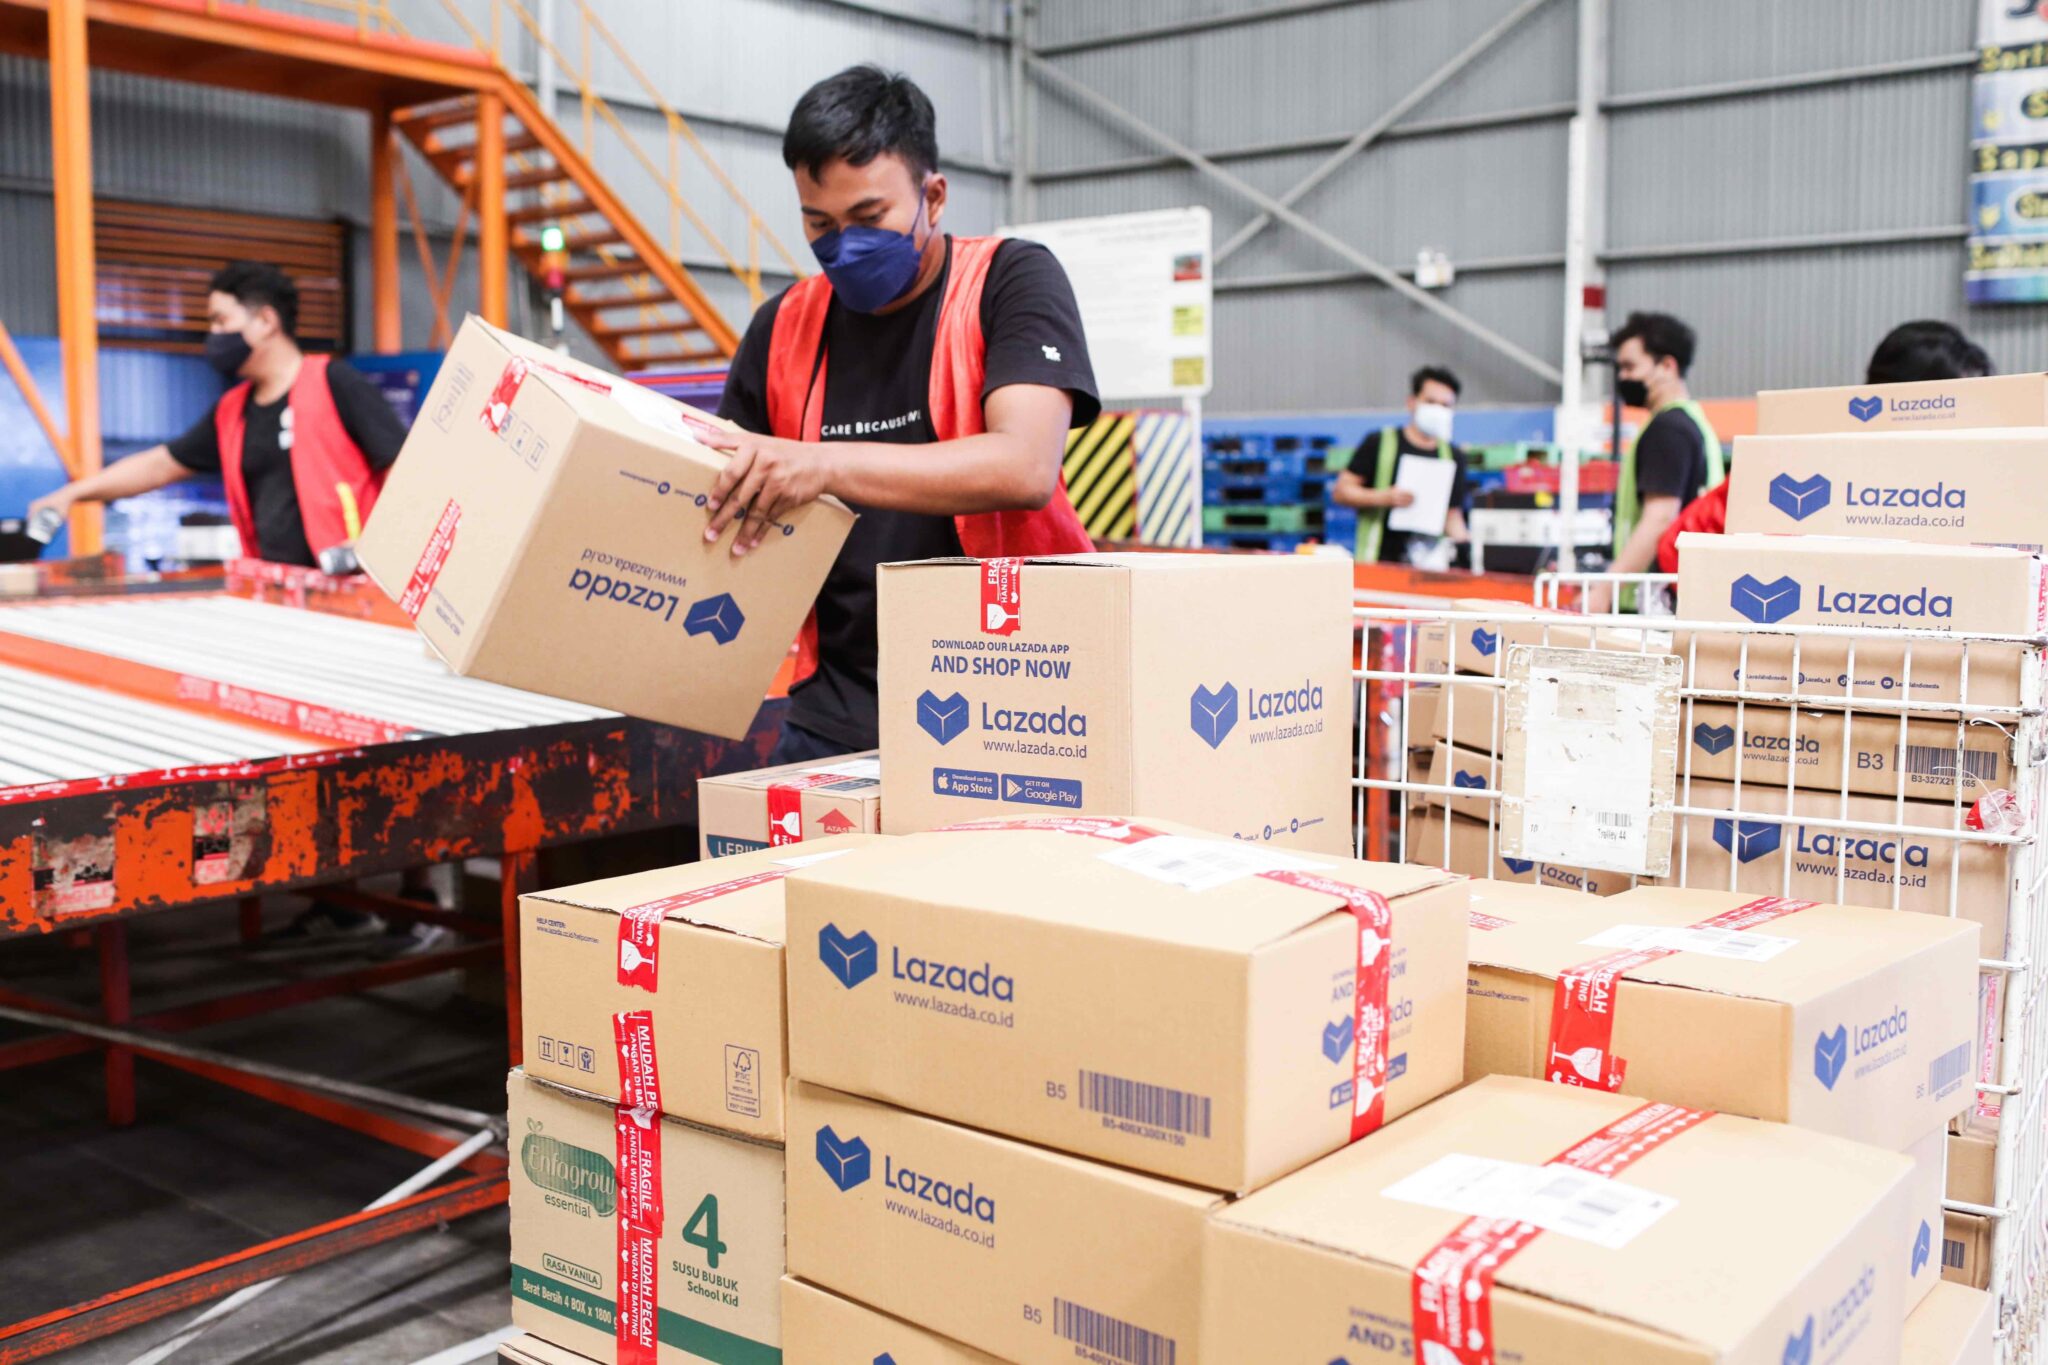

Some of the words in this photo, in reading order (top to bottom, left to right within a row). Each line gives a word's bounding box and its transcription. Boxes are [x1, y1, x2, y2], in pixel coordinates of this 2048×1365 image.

[1891, 394, 1956, 412] Lazada
[821, 424, 851, 437] CARE
[1846, 481, 1966, 509] Lazada
[1846, 514, 1965, 528] www.lazada.co.id
[580, 548, 687, 588] www.lazada.co.id
[568, 568, 679, 622] Lazada
[1000, 568, 1008, 604] HANDLE
[1817, 585, 1953, 618] Lazada
[932, 639, 985, 651] DOWNLOAD
[987, 642, 1007, 652] OUR
[1009, 643, 1048, 654] LAZADA
[1050, 645, 1070, 654] APP
[931, 655, 968, 674] AND
[973, 658, 1021, 677] SHOP
[1026, 660, 1071, 679] NOW
[1249, 679, 1323, 721] Lazada
[982, 702, 1087, 737] Lazada
[1250, 719, 1323, 745] www.lazada.co.id
[983, 740, 1088, 759] www.lazada.co.id
[1743, 731, 1820, 753] Lazada
[1857, 752, 1884, 770] B3
[952, 781, 968, 794] App
[970, 783, 993, 794] Store
[1025, 788, 1057, 803] Google
[1059, 792, 1078, 804] Play
[1796, 825, 1929, 868] Lazada
[892, 946, 1014, 1002] Lazada
[893, 989, 1014, 1028] www.lazada.co.id
[1854, 1004, 1907, 1056] Lazada
[630, 1032, 640, 1073] JANGAN
[639, 1025, 655, 1086] MUDAH
[634, 1076, 641, 1086] DI
[1046, 1081, 1067, 1100] B5
[629, 1126, 637, 1165] HANDLE
[528, 1144, 615, 1195] Enfagrow
[630, 1168, 638, 1194] WITH
[641, 1150, 652, 1212] FRAGILE
[884, 1155, 995, 1224] Lazada
[544, 1193, 591, 1219] essential
[682, 1193, 727, 1269] 4
[885, 1198, 995, 1249] www.lazada.co.id
[546, 1257, 568, 1274] RASA
[567, 1264, 598, 1285] VANILA
[642, 1237, 653, 1297] MUDAH
[672, 1260, 700, 1279] SUSU
[702, 1269, 738, 1292] BUBUK
[522, 1278, 540, 1297] Berat
[542, 1286, 563, 1306] Bersih
[564, 1295, 569, 1308] 4
[571, 1298, 586, 1315] BOX
[587, 1306, 593, 1317] x
[632, 1282, 639, 1292] DI
[687, 1280, 720, 1302] School
[722, 1292, 739, 1308] Kid
[642, 1300, 653, 1348] PECAH
[1023, 1304, 1042, 1325] B5
[1348, 1323, 1395, 1353] AND
